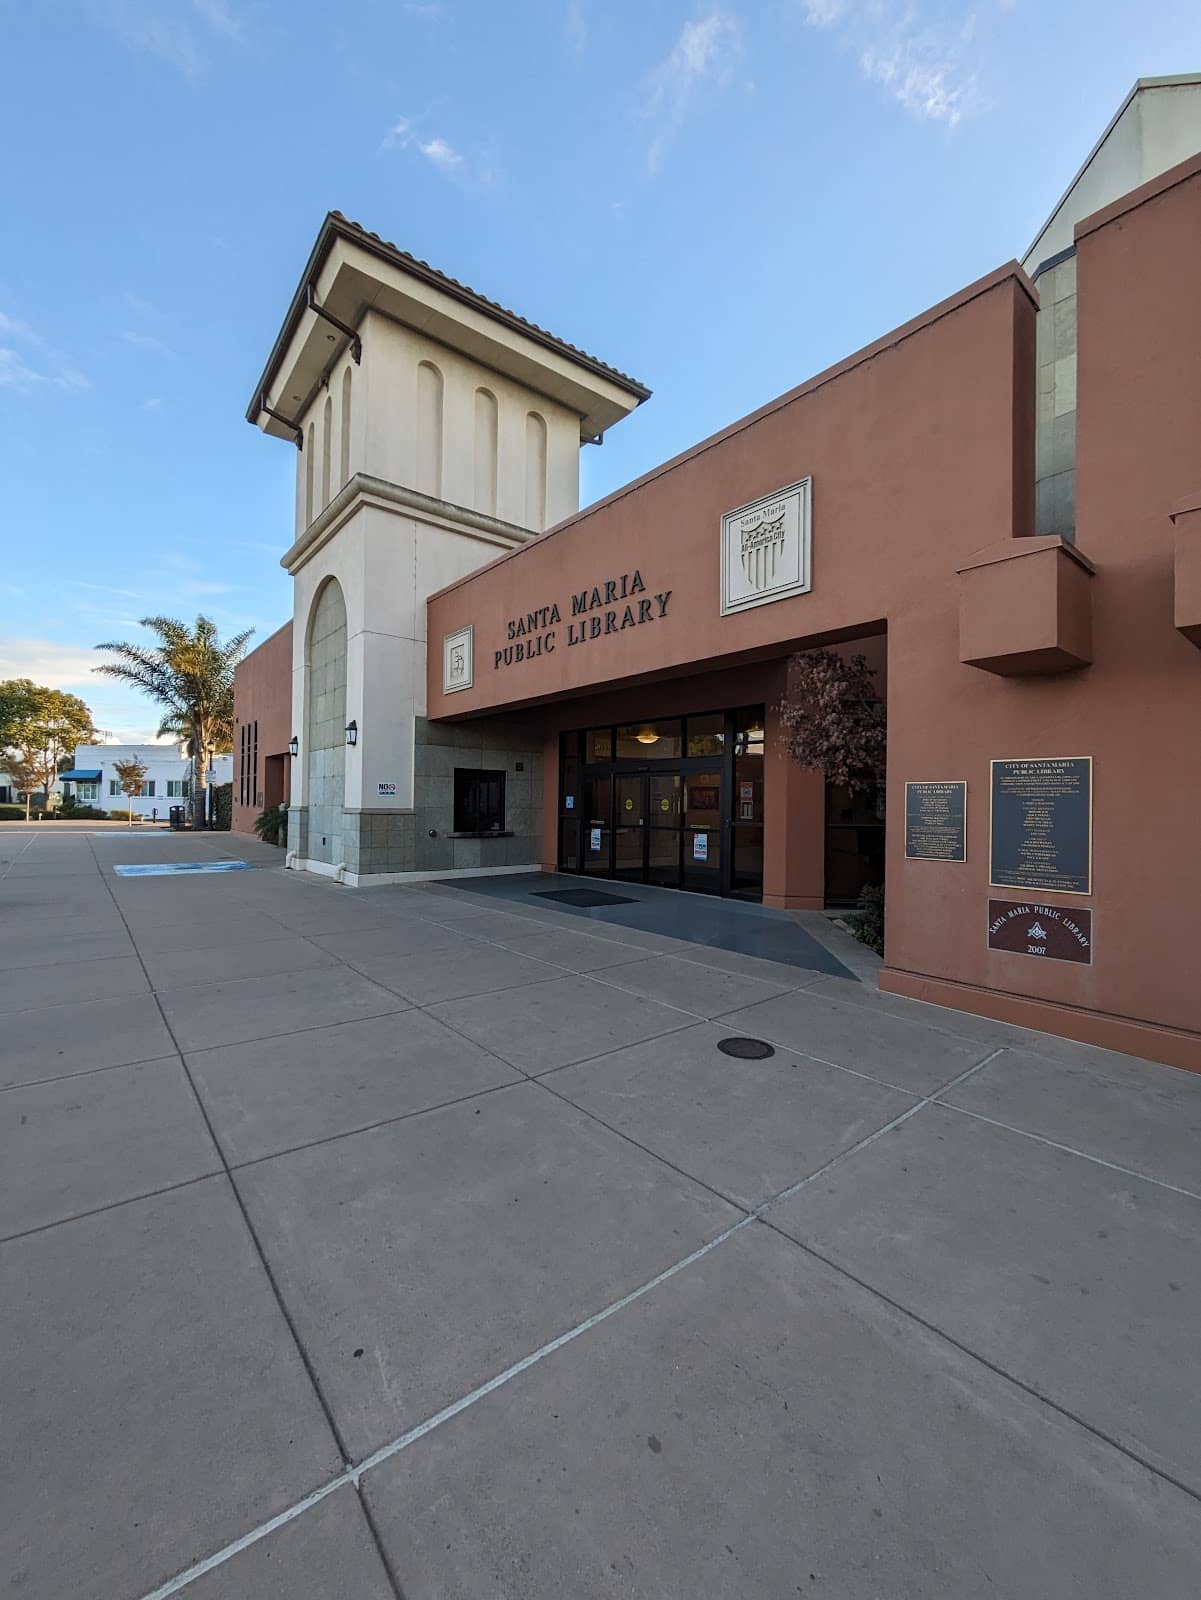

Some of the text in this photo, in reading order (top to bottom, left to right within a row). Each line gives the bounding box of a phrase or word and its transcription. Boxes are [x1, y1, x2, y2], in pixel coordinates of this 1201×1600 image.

[741, 504, 785, 527] Santa Maria
[507, 569, 647, 640] SANTA MARIA
[494, 590, 673, 670] PUBLIC LIBRARY
[989, 905, 1090, 948] SANTA MARIA PUBLIC LIBRARY
[1027, 944, 1047, 955] 2007
